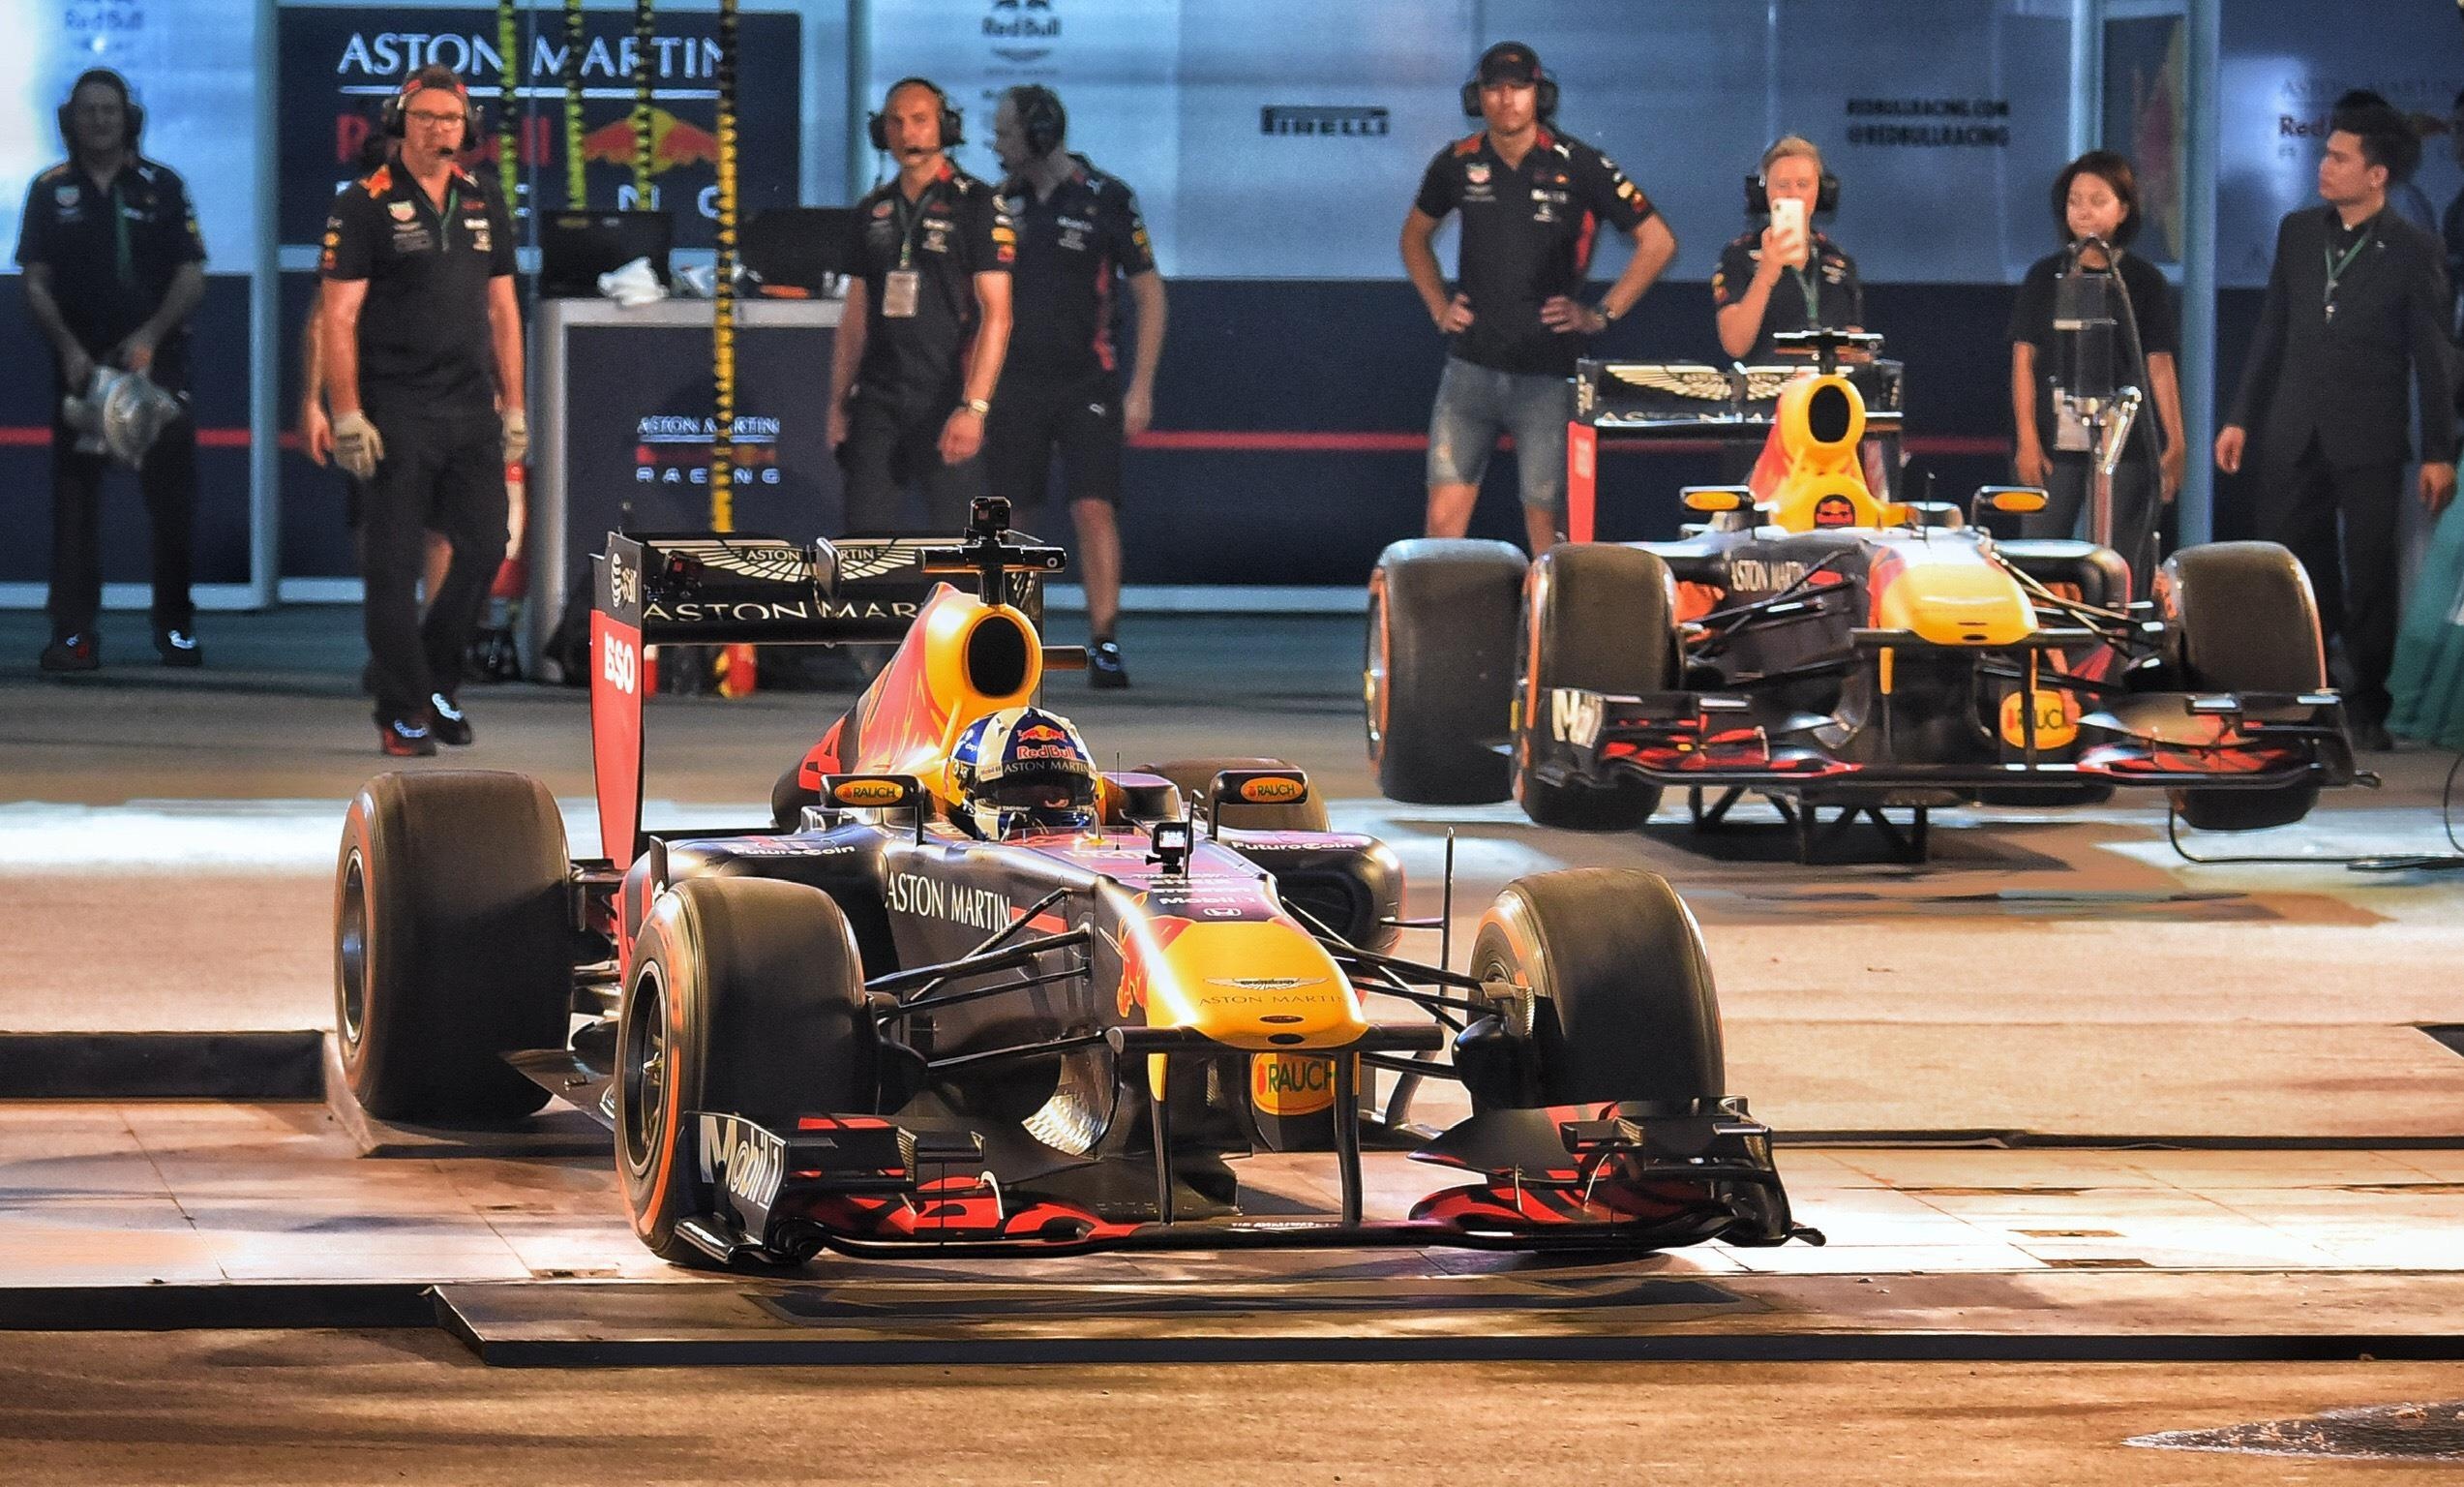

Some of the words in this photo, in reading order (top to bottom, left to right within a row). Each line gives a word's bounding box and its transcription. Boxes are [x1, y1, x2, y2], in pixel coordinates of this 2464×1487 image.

[981, 16, 1022, 36] Red
[1025, 16, 1063, 36] Bull
[337, 33, 503, 76] ASTON
[1261, 105, 1389, 136] PIRELLI
[636, 467, 781, 484] RACNG
[746, 549, 800, 561] ASTON
[644, 599, 808, 622] ASTON
[1017, 745, 1048, 759] Red
[1050, 745, 1076, 759] Bull
[1005, 760, 1045, 774] ASTON
[853, 786, 896, 799] RAUCH
[1257, 783, 1296, 797] RAUCH
[886, 871, 945, 920] ASTON
[951, 882, 1012, 933] MARTIN
[1200, 995, 1262, 1007] ASTON
[700, 1115, 769, 1202] Mobil
